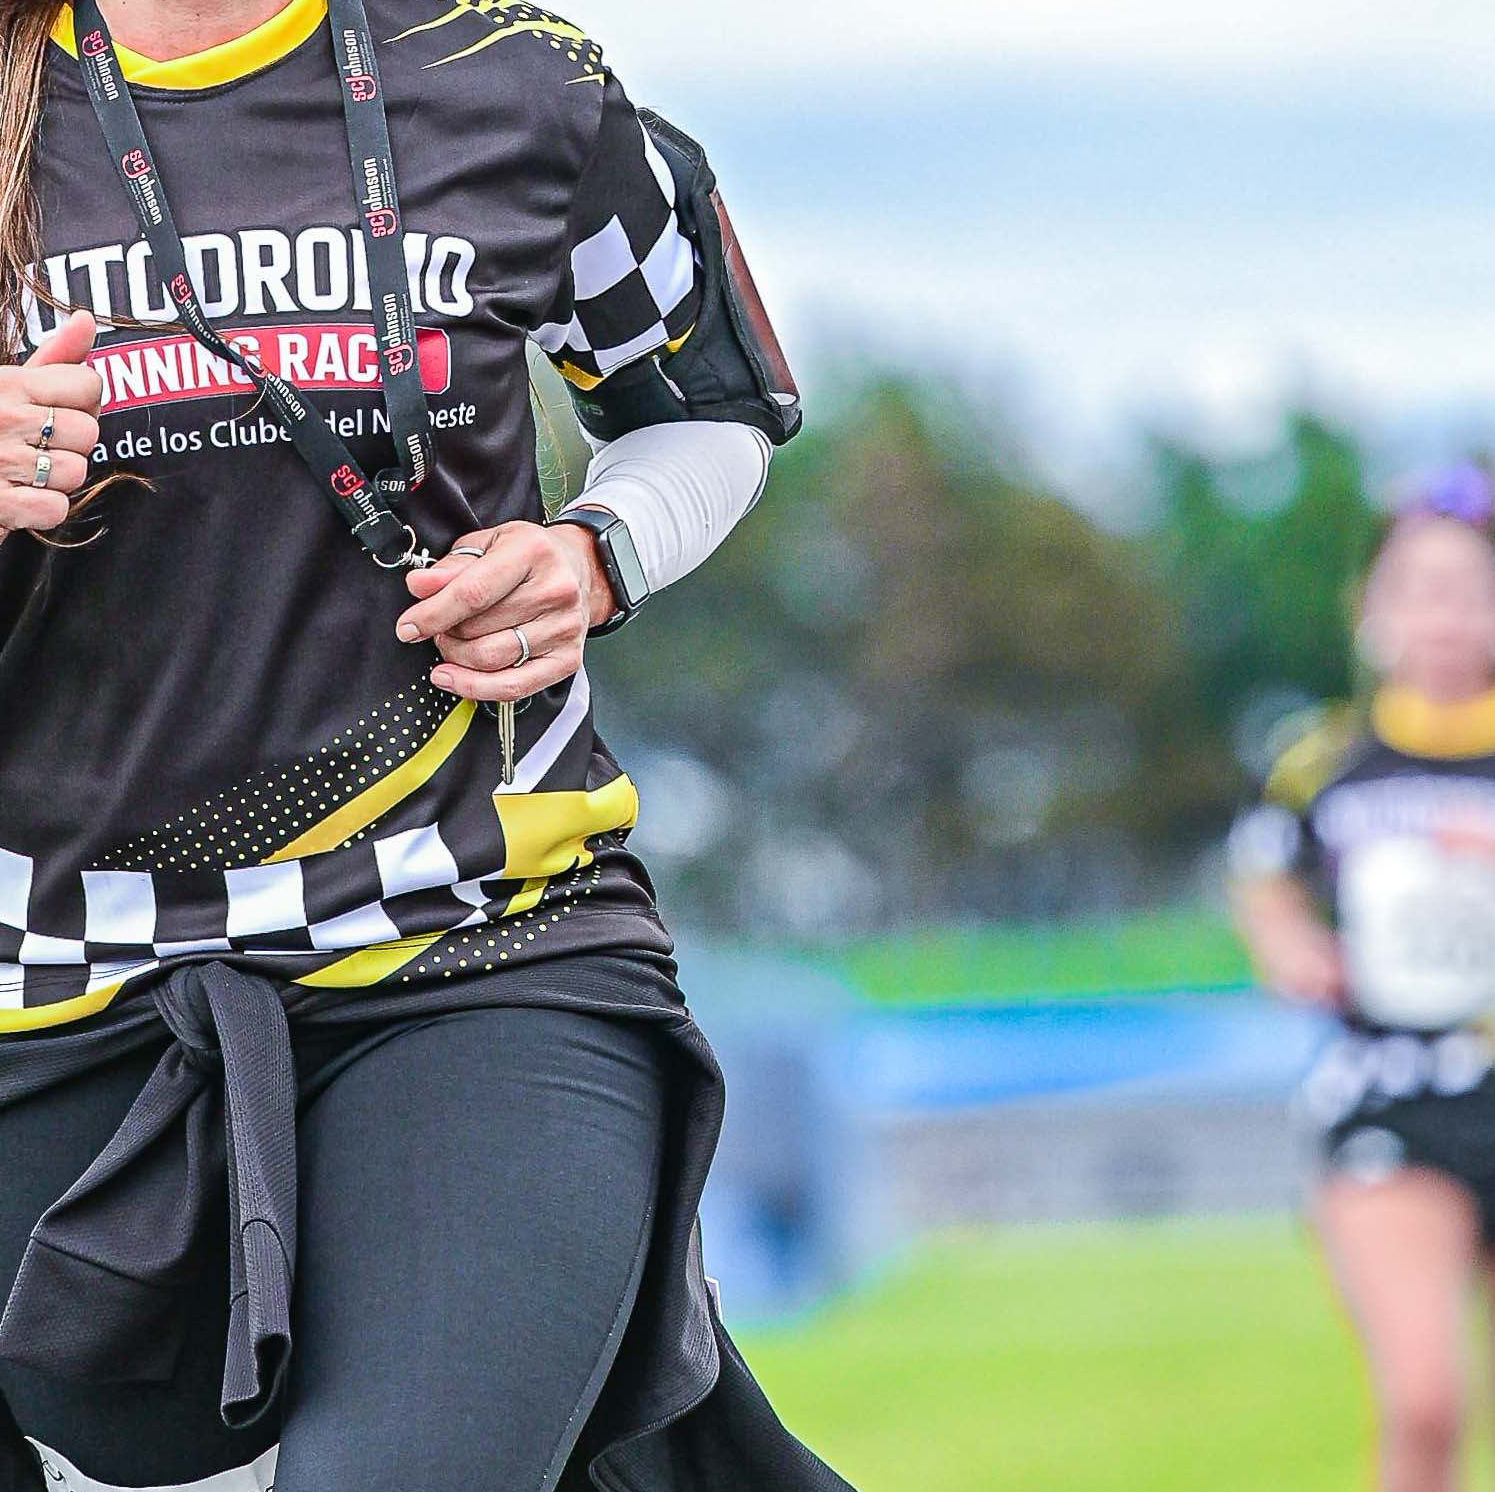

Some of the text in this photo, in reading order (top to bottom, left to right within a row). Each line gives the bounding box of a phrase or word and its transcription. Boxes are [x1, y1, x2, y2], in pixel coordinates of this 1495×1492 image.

[85, 335, 262, 407] UNNING
[277, 332, 384, 382] RAC
[115, 430, 153, 459] de
[159, 426, 203, 454] los
